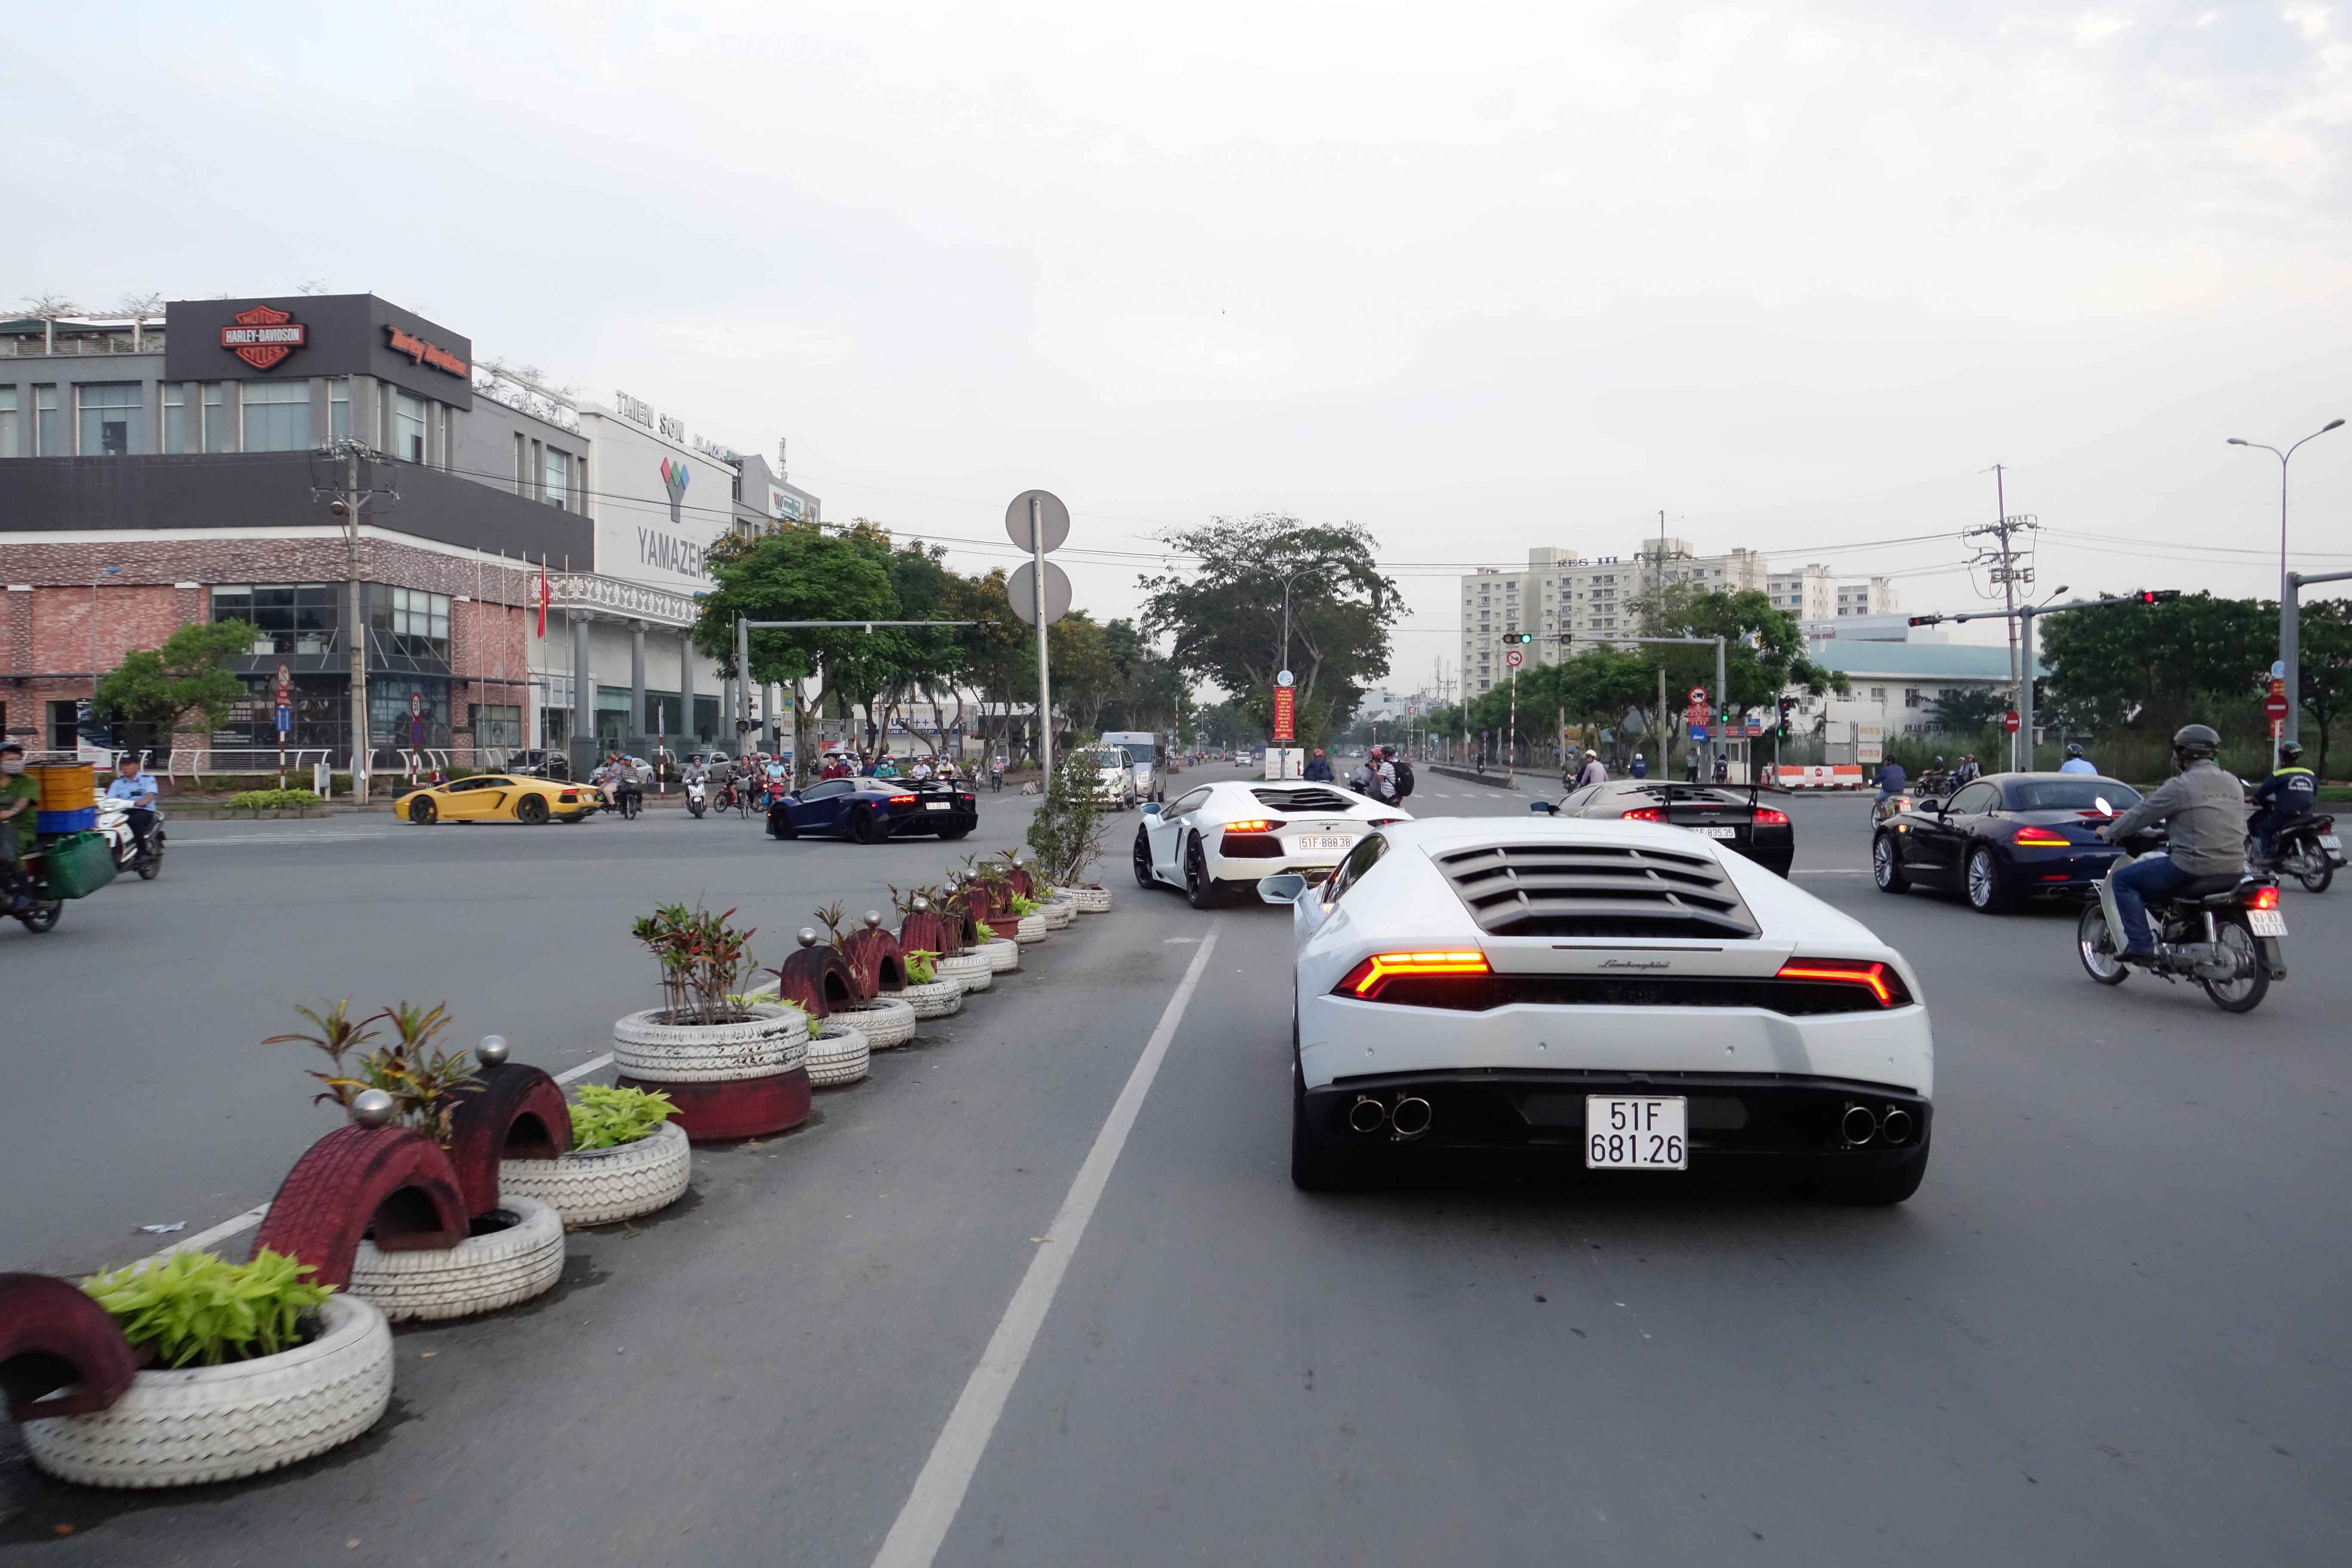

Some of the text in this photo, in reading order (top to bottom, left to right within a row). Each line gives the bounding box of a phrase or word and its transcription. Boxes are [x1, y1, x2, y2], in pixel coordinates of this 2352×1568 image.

[226, 328, 300, 343] HARLEY-DAVIDSON
[637, 526, 706, 580] YAMAZEN
[1598, 959, 1671, 971] Lamborghini
[1611, 1102, 1662, 1131] 51F
[1591, 1133, 1683, 1164] 681.26
